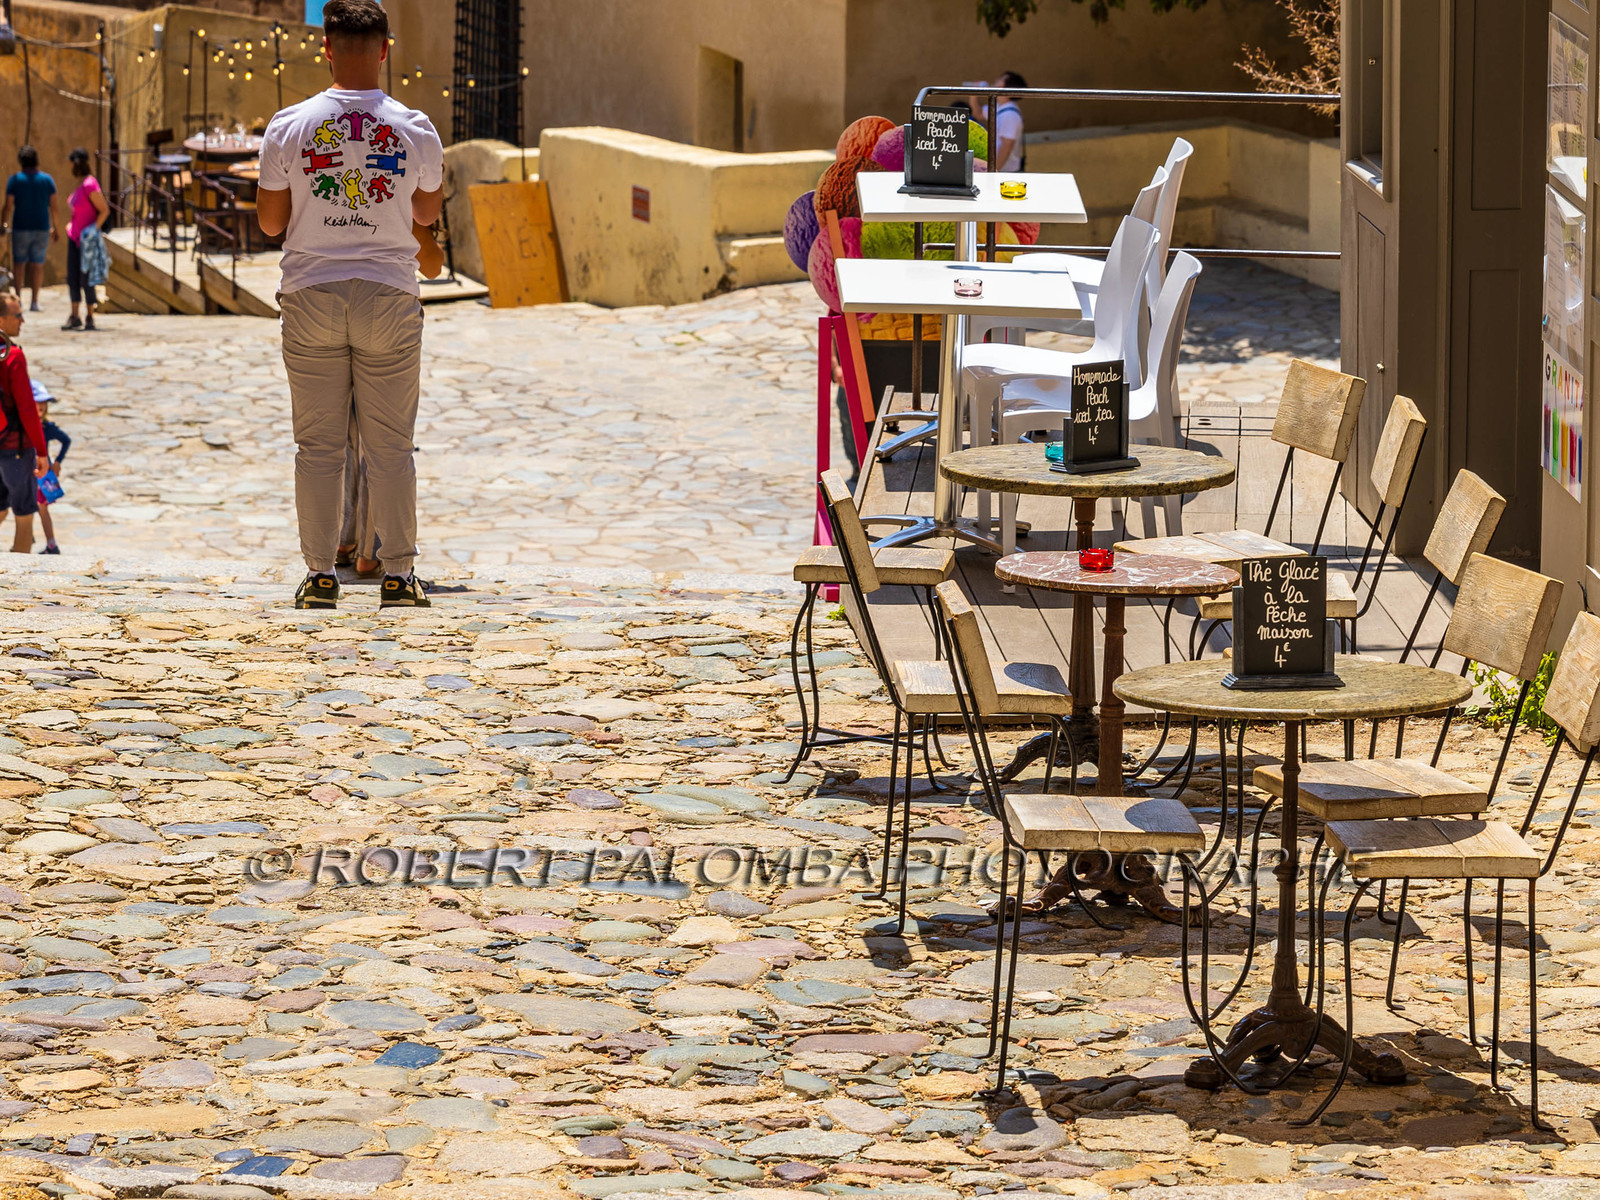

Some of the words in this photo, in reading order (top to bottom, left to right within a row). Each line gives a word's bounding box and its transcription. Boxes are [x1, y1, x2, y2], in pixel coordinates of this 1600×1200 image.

[914, 107, 966, 124] Homemade
[927, 121, 956, 138] Peach
[915, 137, 938, 150] iced
[941, 139, 960, 153] tea
[932, 154, 943, 171] 4€
[1073, 366, 1121, 386] Homemade
[1545, 353, 1584, 412] GRANIT
[1086, 385, 1109, 406] Peach
[1074, 407, 1092, 424] iced
[1095, 406, 1115, 422] tea
[1088, 425, 1099, 445] 4€
[1243, 560, 1273, 582] Thé
[1278, 559, 1320, 593] Glacé
[1264, 586, 1277, 605] à
[1285, 585, 1309, 604] la
[1266, 605, 1307, 623] Pêche
[1274, 642, 1291, 669] 4€
